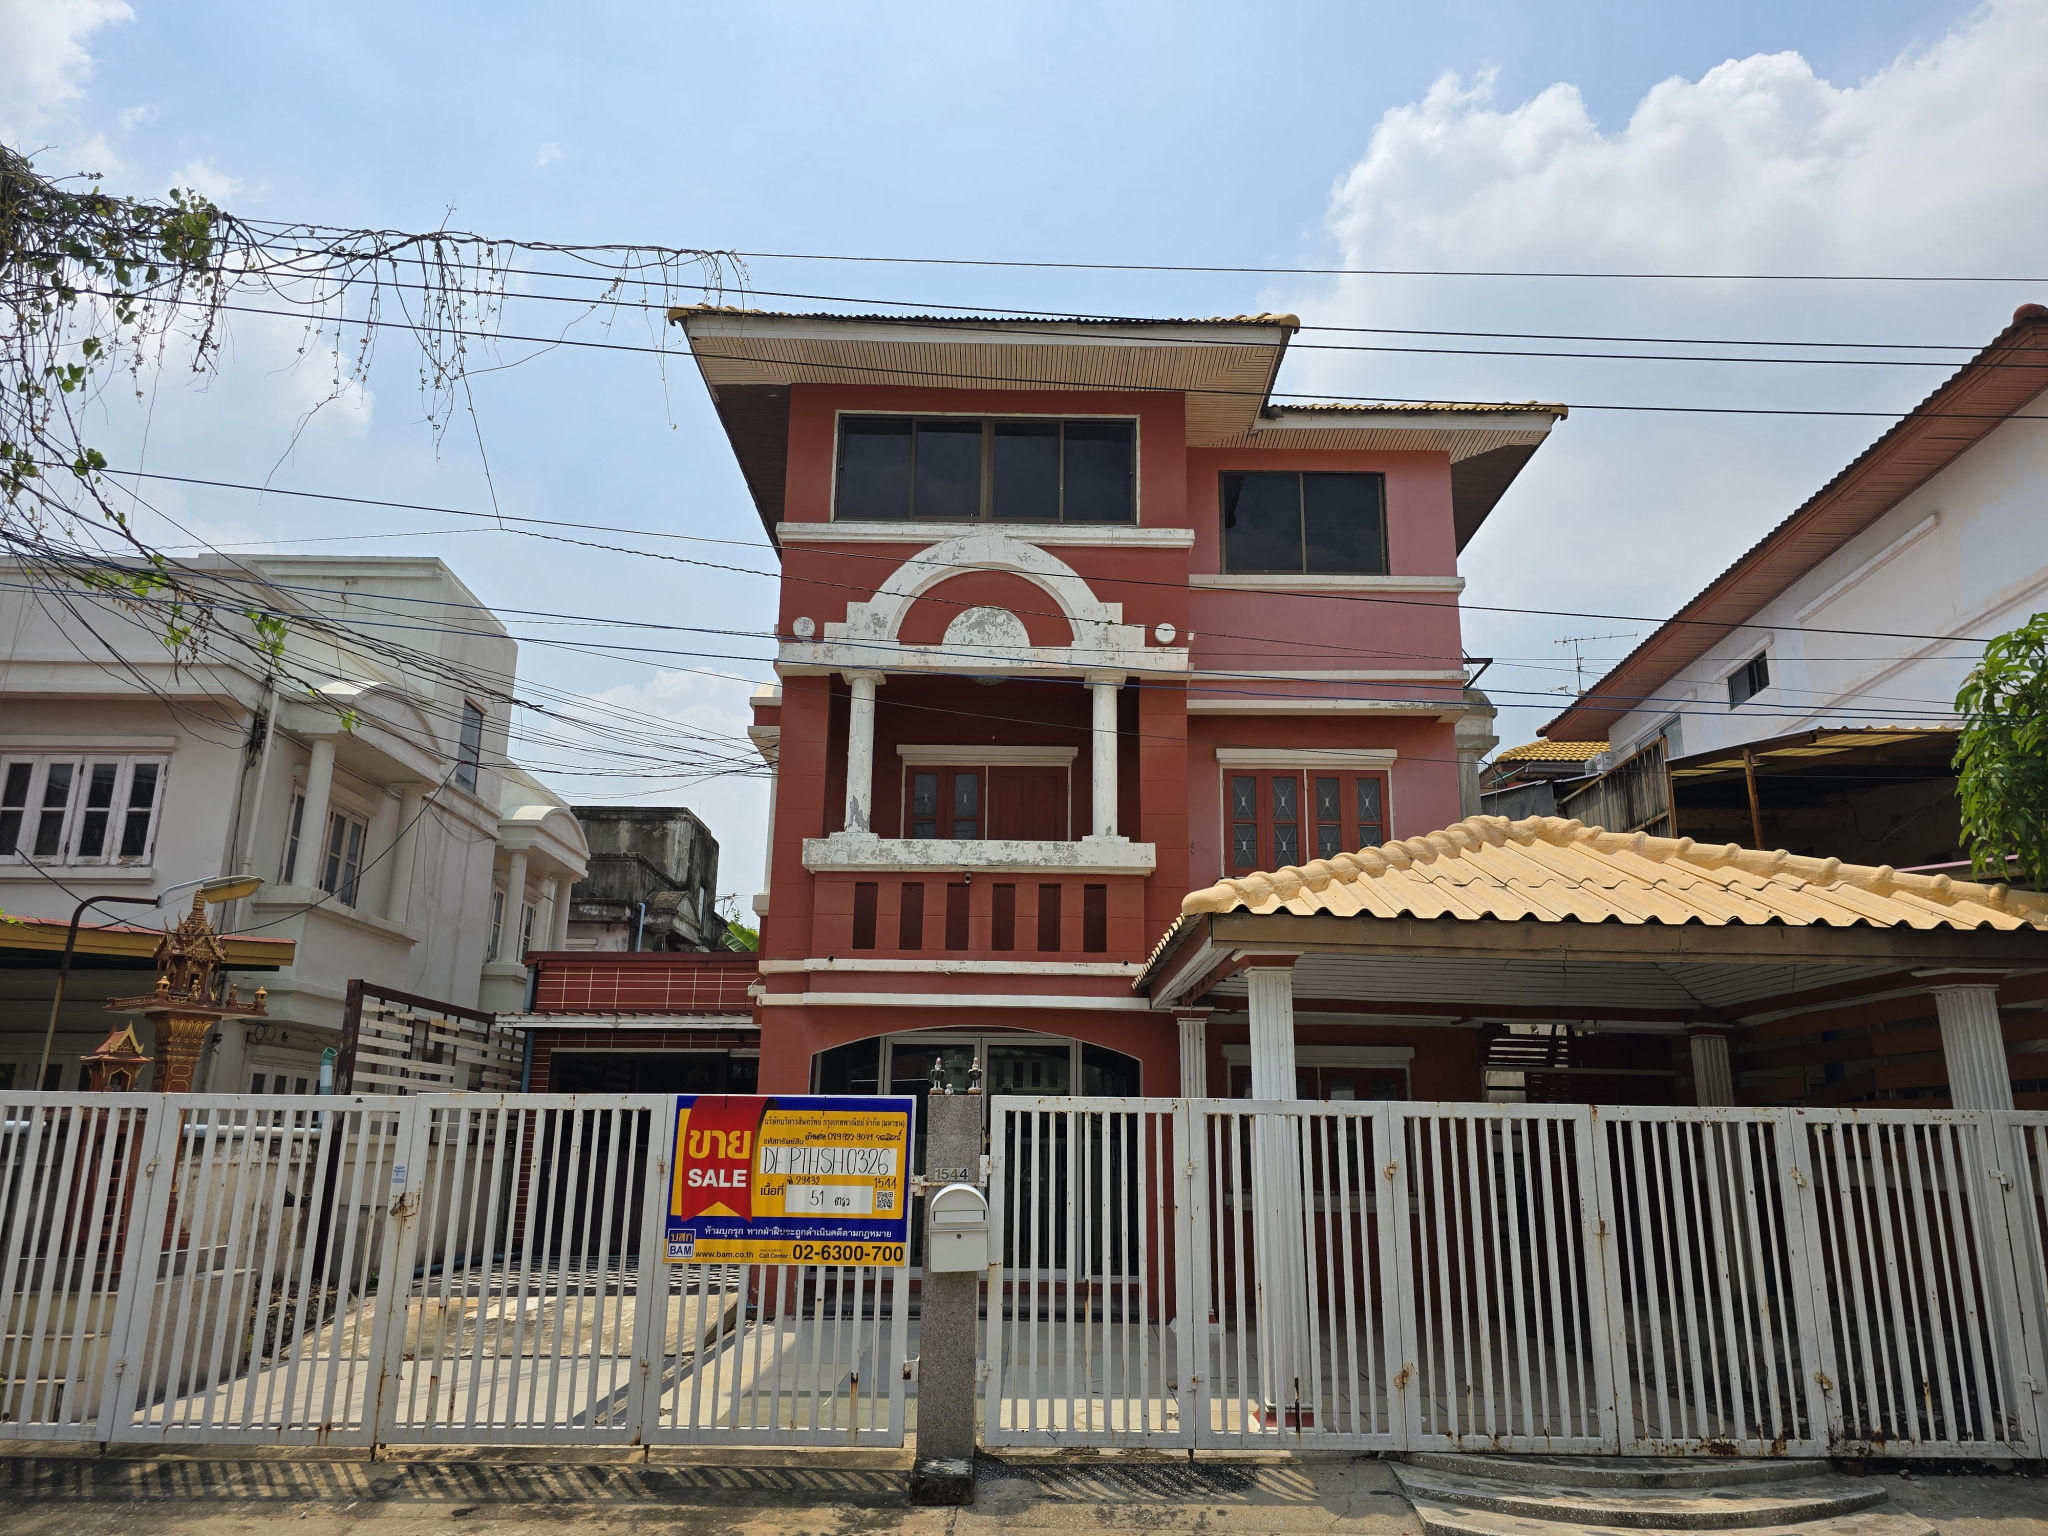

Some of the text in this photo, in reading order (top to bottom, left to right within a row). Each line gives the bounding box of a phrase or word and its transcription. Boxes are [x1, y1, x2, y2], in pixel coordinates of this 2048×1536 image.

[689, 1129, 752, 1159] ขาย
[687, 1168, 748, 1188] SALE
[935, 1168, 968, 1180] 1544
[760, 1182, 785, 1196] เนื้อที่
[874, 1177, 897, 1189] 1544
[809, 1190, 824, 1206] 51
[670, 1231, 693, 1242] บสก
[704, 1225, 744, 1238] ห้ามบุกรุก
[669, 1245, 692, 1256] BAM
[696, 1250, 754, 1258] www.bam.co.th
[793, 1244, 904, 1262] 02-6300-700
